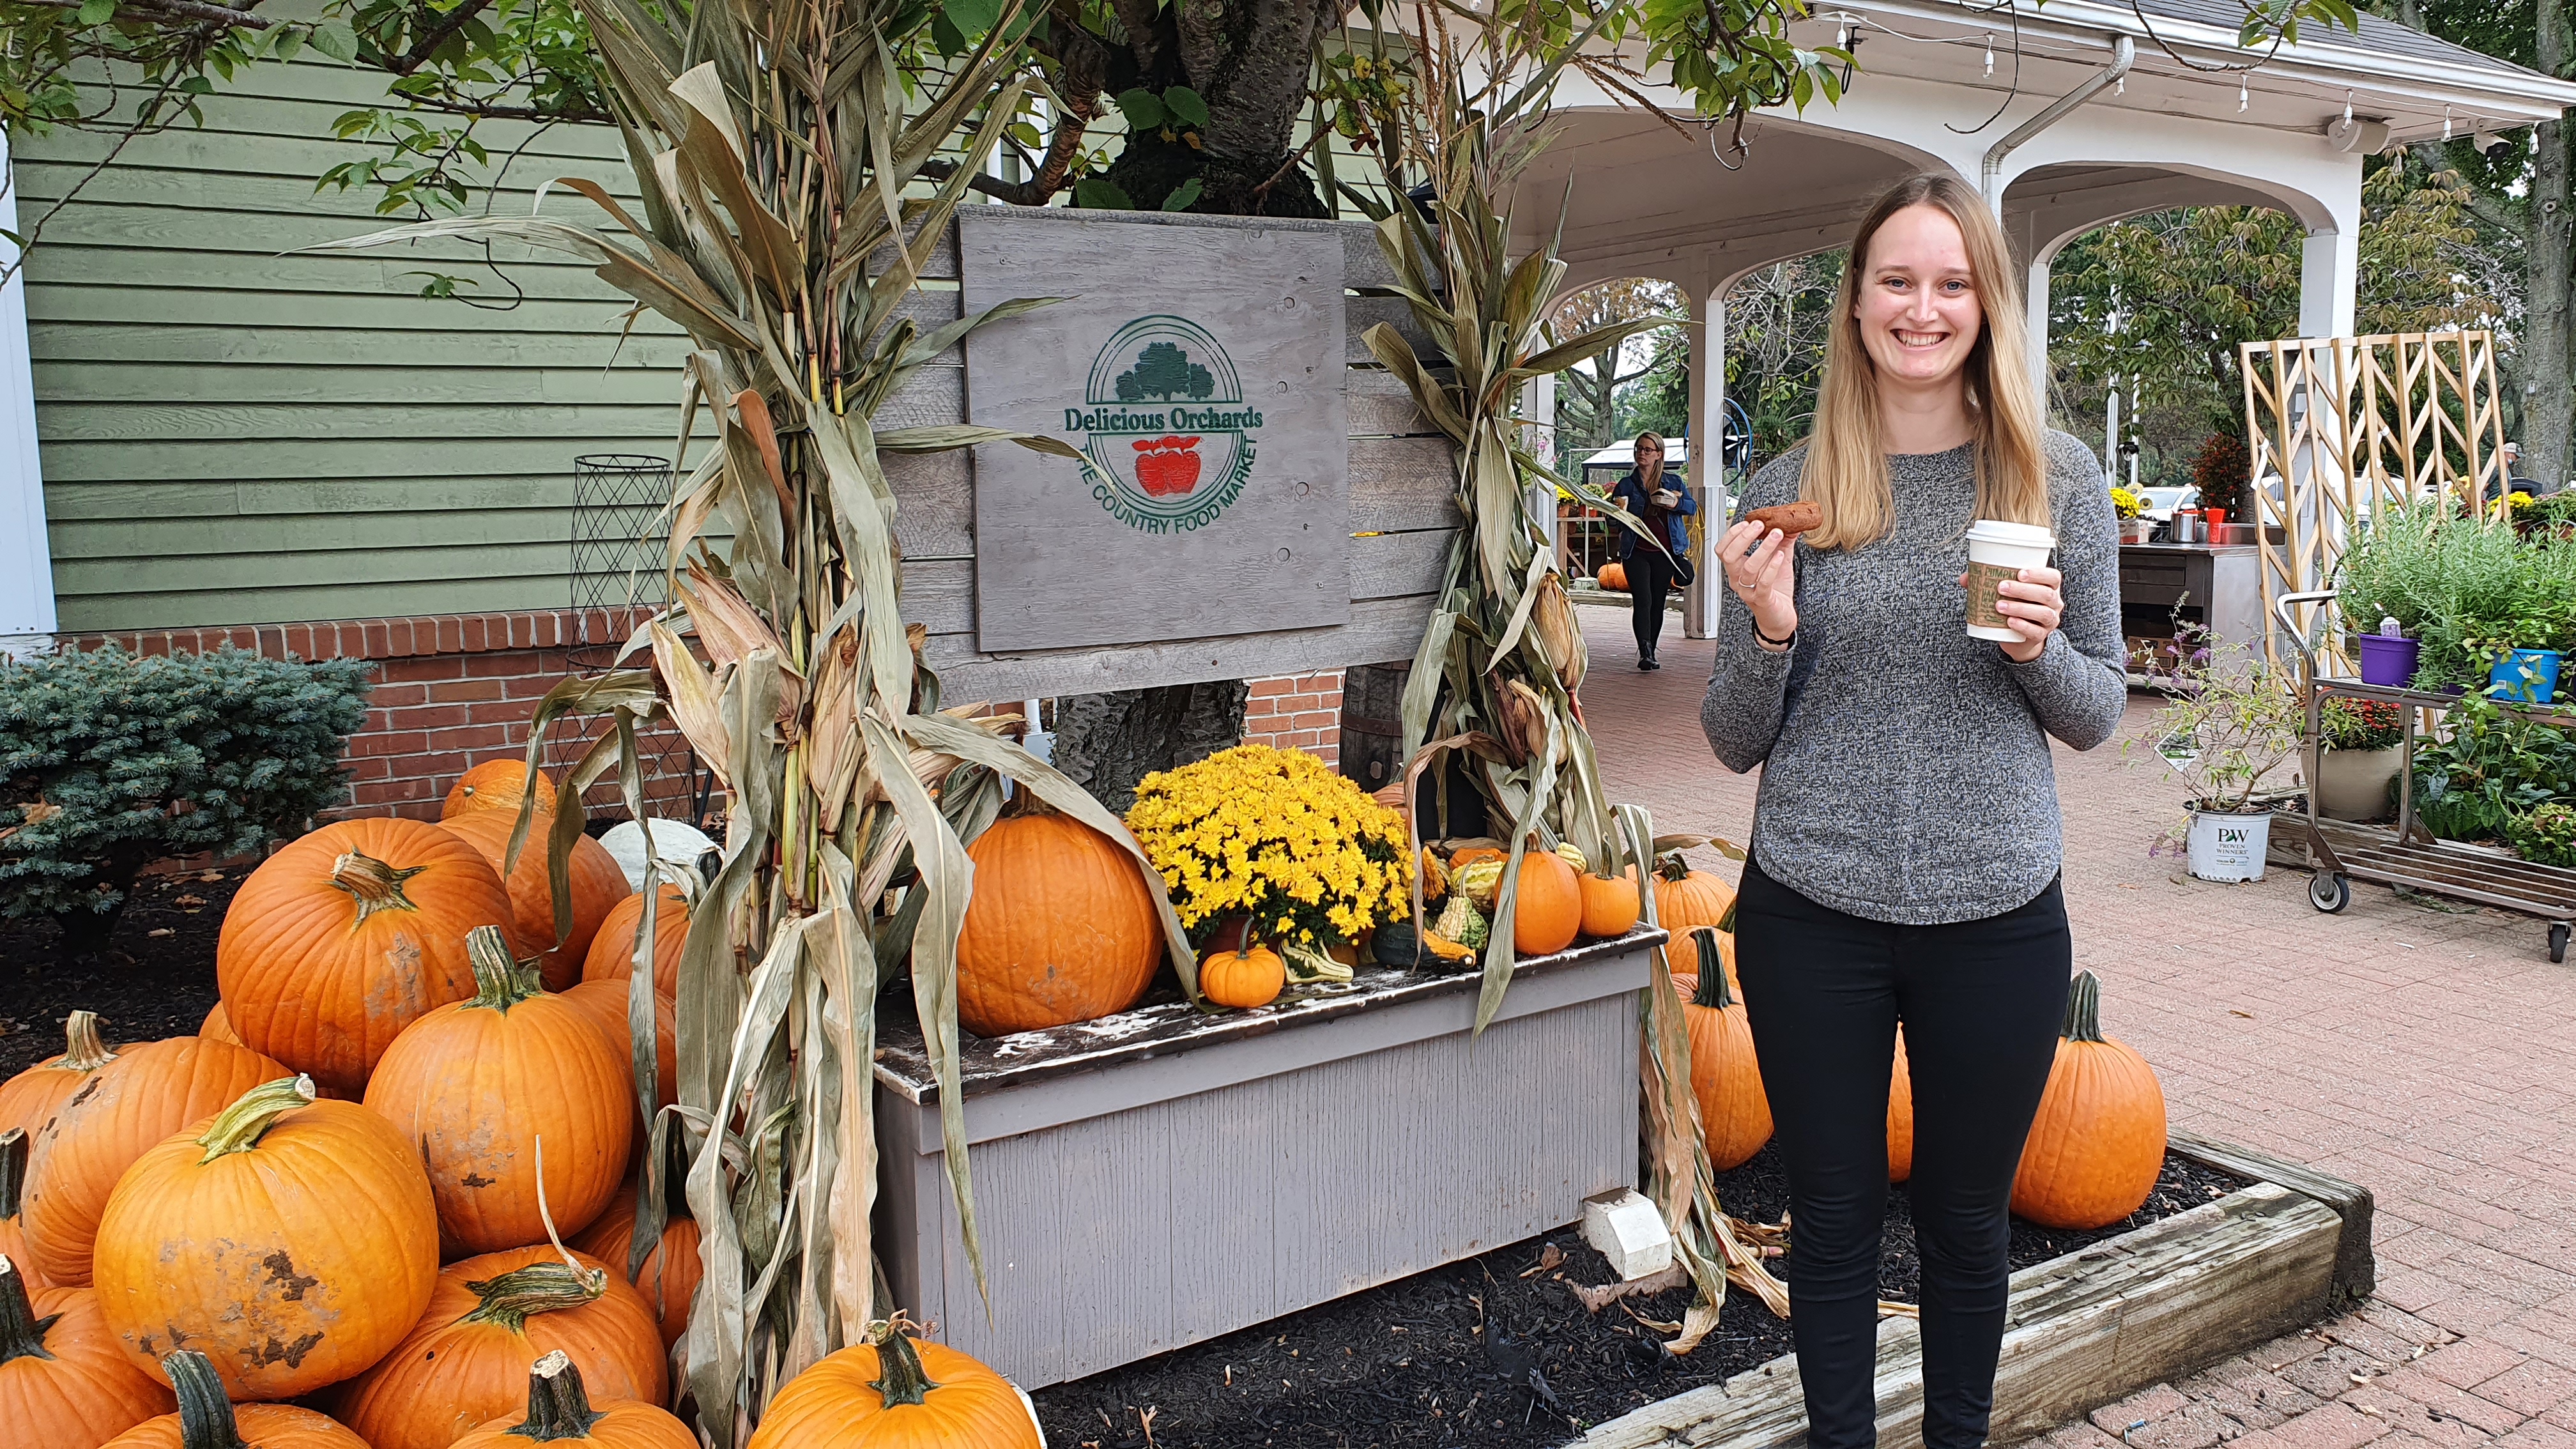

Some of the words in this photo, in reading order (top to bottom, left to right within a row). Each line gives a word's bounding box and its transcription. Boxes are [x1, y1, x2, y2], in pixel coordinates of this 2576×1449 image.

[1064, 408, 1165, 431] Delicious
[1171, 406, 1263, 429] Orchards
[1077, 443, 1098, 485] THE
[1093, 485, 1170, 535] COUNTRY
[1174, 503, 1220, 534] FOOD
[1220, 435, 1257, 508] MARKET
[2218, 828, 2250, 843] PW
